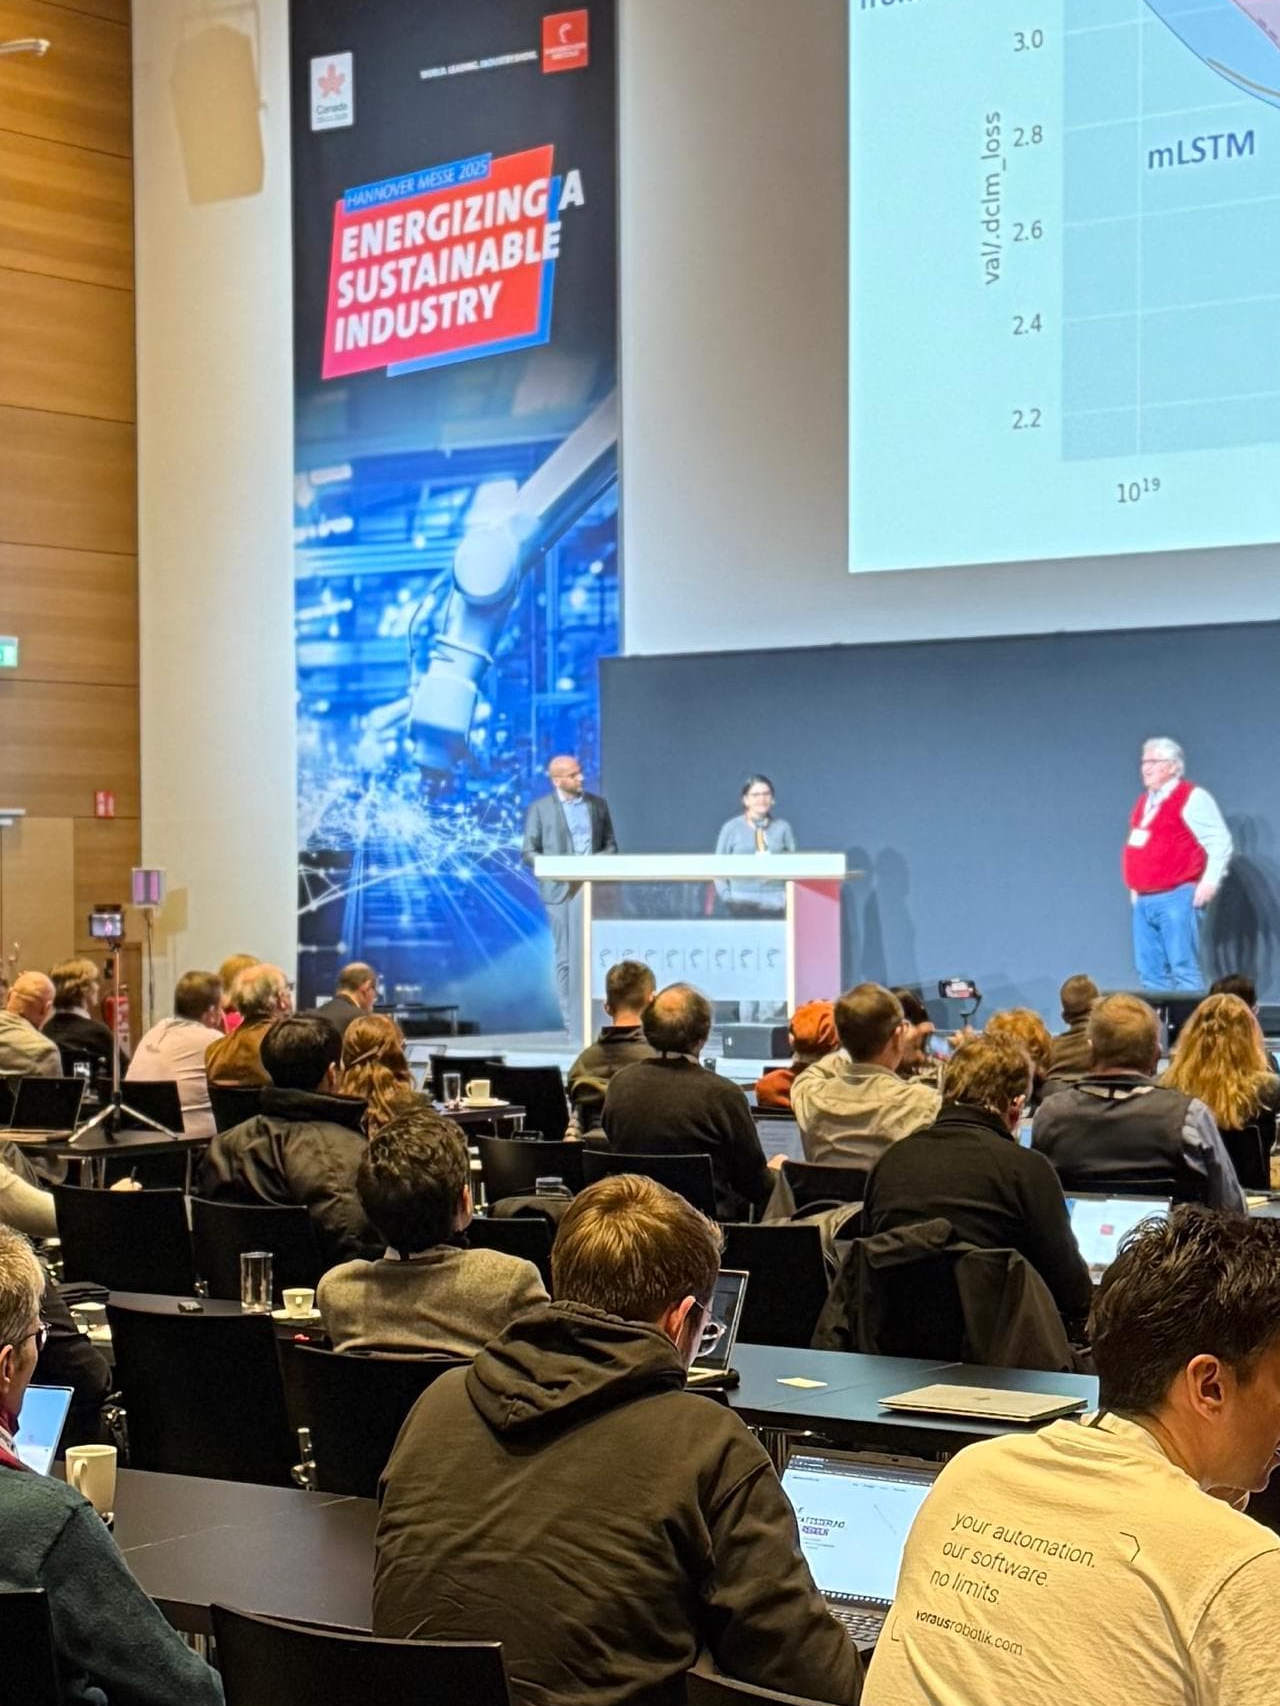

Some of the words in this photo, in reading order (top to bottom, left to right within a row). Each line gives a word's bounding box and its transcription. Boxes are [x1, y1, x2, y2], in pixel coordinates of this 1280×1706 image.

[1013, 29, 1044, 52] 3.0
[1013, 125, 1043, 148] 2.8
[1148, 129, 1256, 170] mLSTM
[346, 179, 415, 208] HANNOVER
[418, 167, 454, 190] MESSE
[459, 159, 489, 177] 2025
[340, 177, 548, 264] ENERGIZING
[557, 169, 585, 211] A
[1012, 220, 1043, 242] 2.6
[336, 220, 562, 308] SUSTAINABLE
[333, 281, 503, 353] INDUSTRY
[1012, 313, 1043, 335] 2.4
[1012, 408, 1042, 429] 2.2
[951, 1512, 992, 1535] your
[992, 1525, 1096, 1568] automation.
[942, 1541, 970, 1561] our
[971, 1549, 1049, 1588] software.
[929, 1569, 950, 1587] no
[951, 1572, 1001, 1606] limits.
